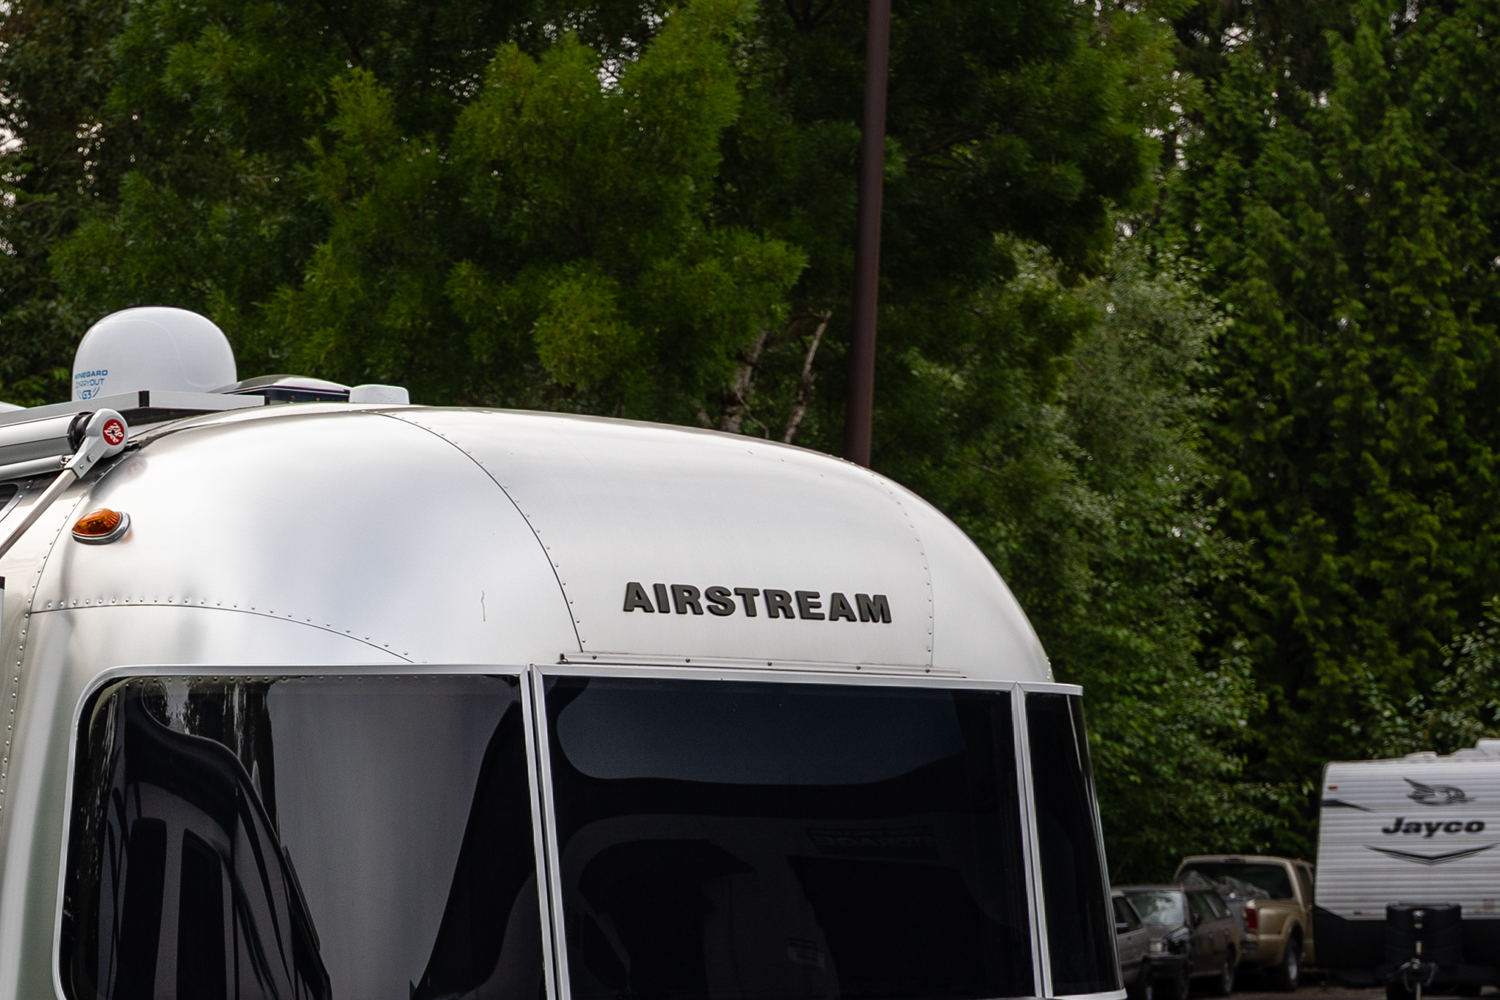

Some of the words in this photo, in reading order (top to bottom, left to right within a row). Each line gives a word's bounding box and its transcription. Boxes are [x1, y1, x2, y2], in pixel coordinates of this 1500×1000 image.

[74, 369, 108, 379] WINEGARD
[82, 390, 92, 399] G3
[622, 581, 892, 624] AIRSTREAM
[1382, 817, 1485, 838] Jayco
